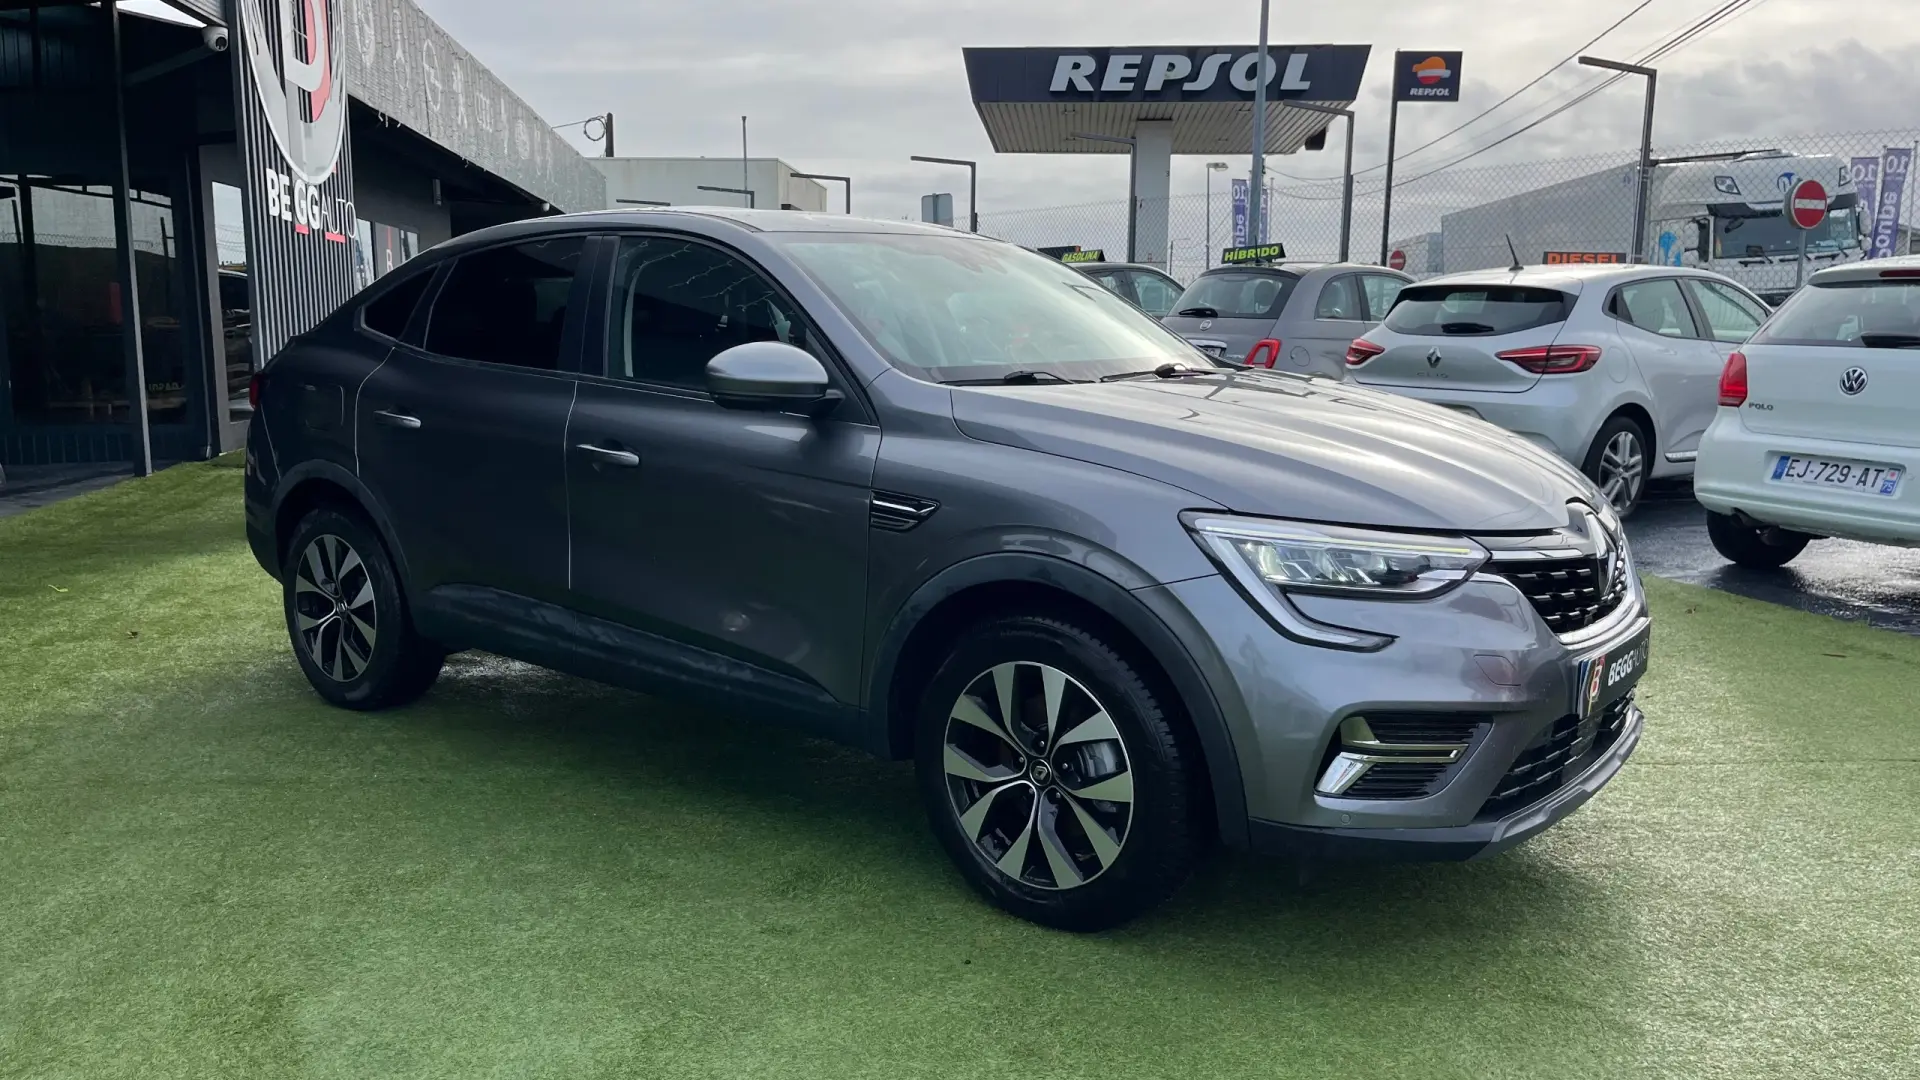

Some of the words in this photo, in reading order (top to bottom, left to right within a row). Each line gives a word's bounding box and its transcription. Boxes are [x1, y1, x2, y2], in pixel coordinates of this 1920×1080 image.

[1049, 52, 1311, 92] REPSOL
[1409, 88, 1451, 96] REPSOL
[1062, 250, 1098, 262] GASOLINA
[1224, 246, 1279, 261] HÍBRIDO
[1748, 402, 1774, 411] POLO
[1785, 459, 1885, 488] EJ-729-AT
[1882, 481, 1894, 492] 75
